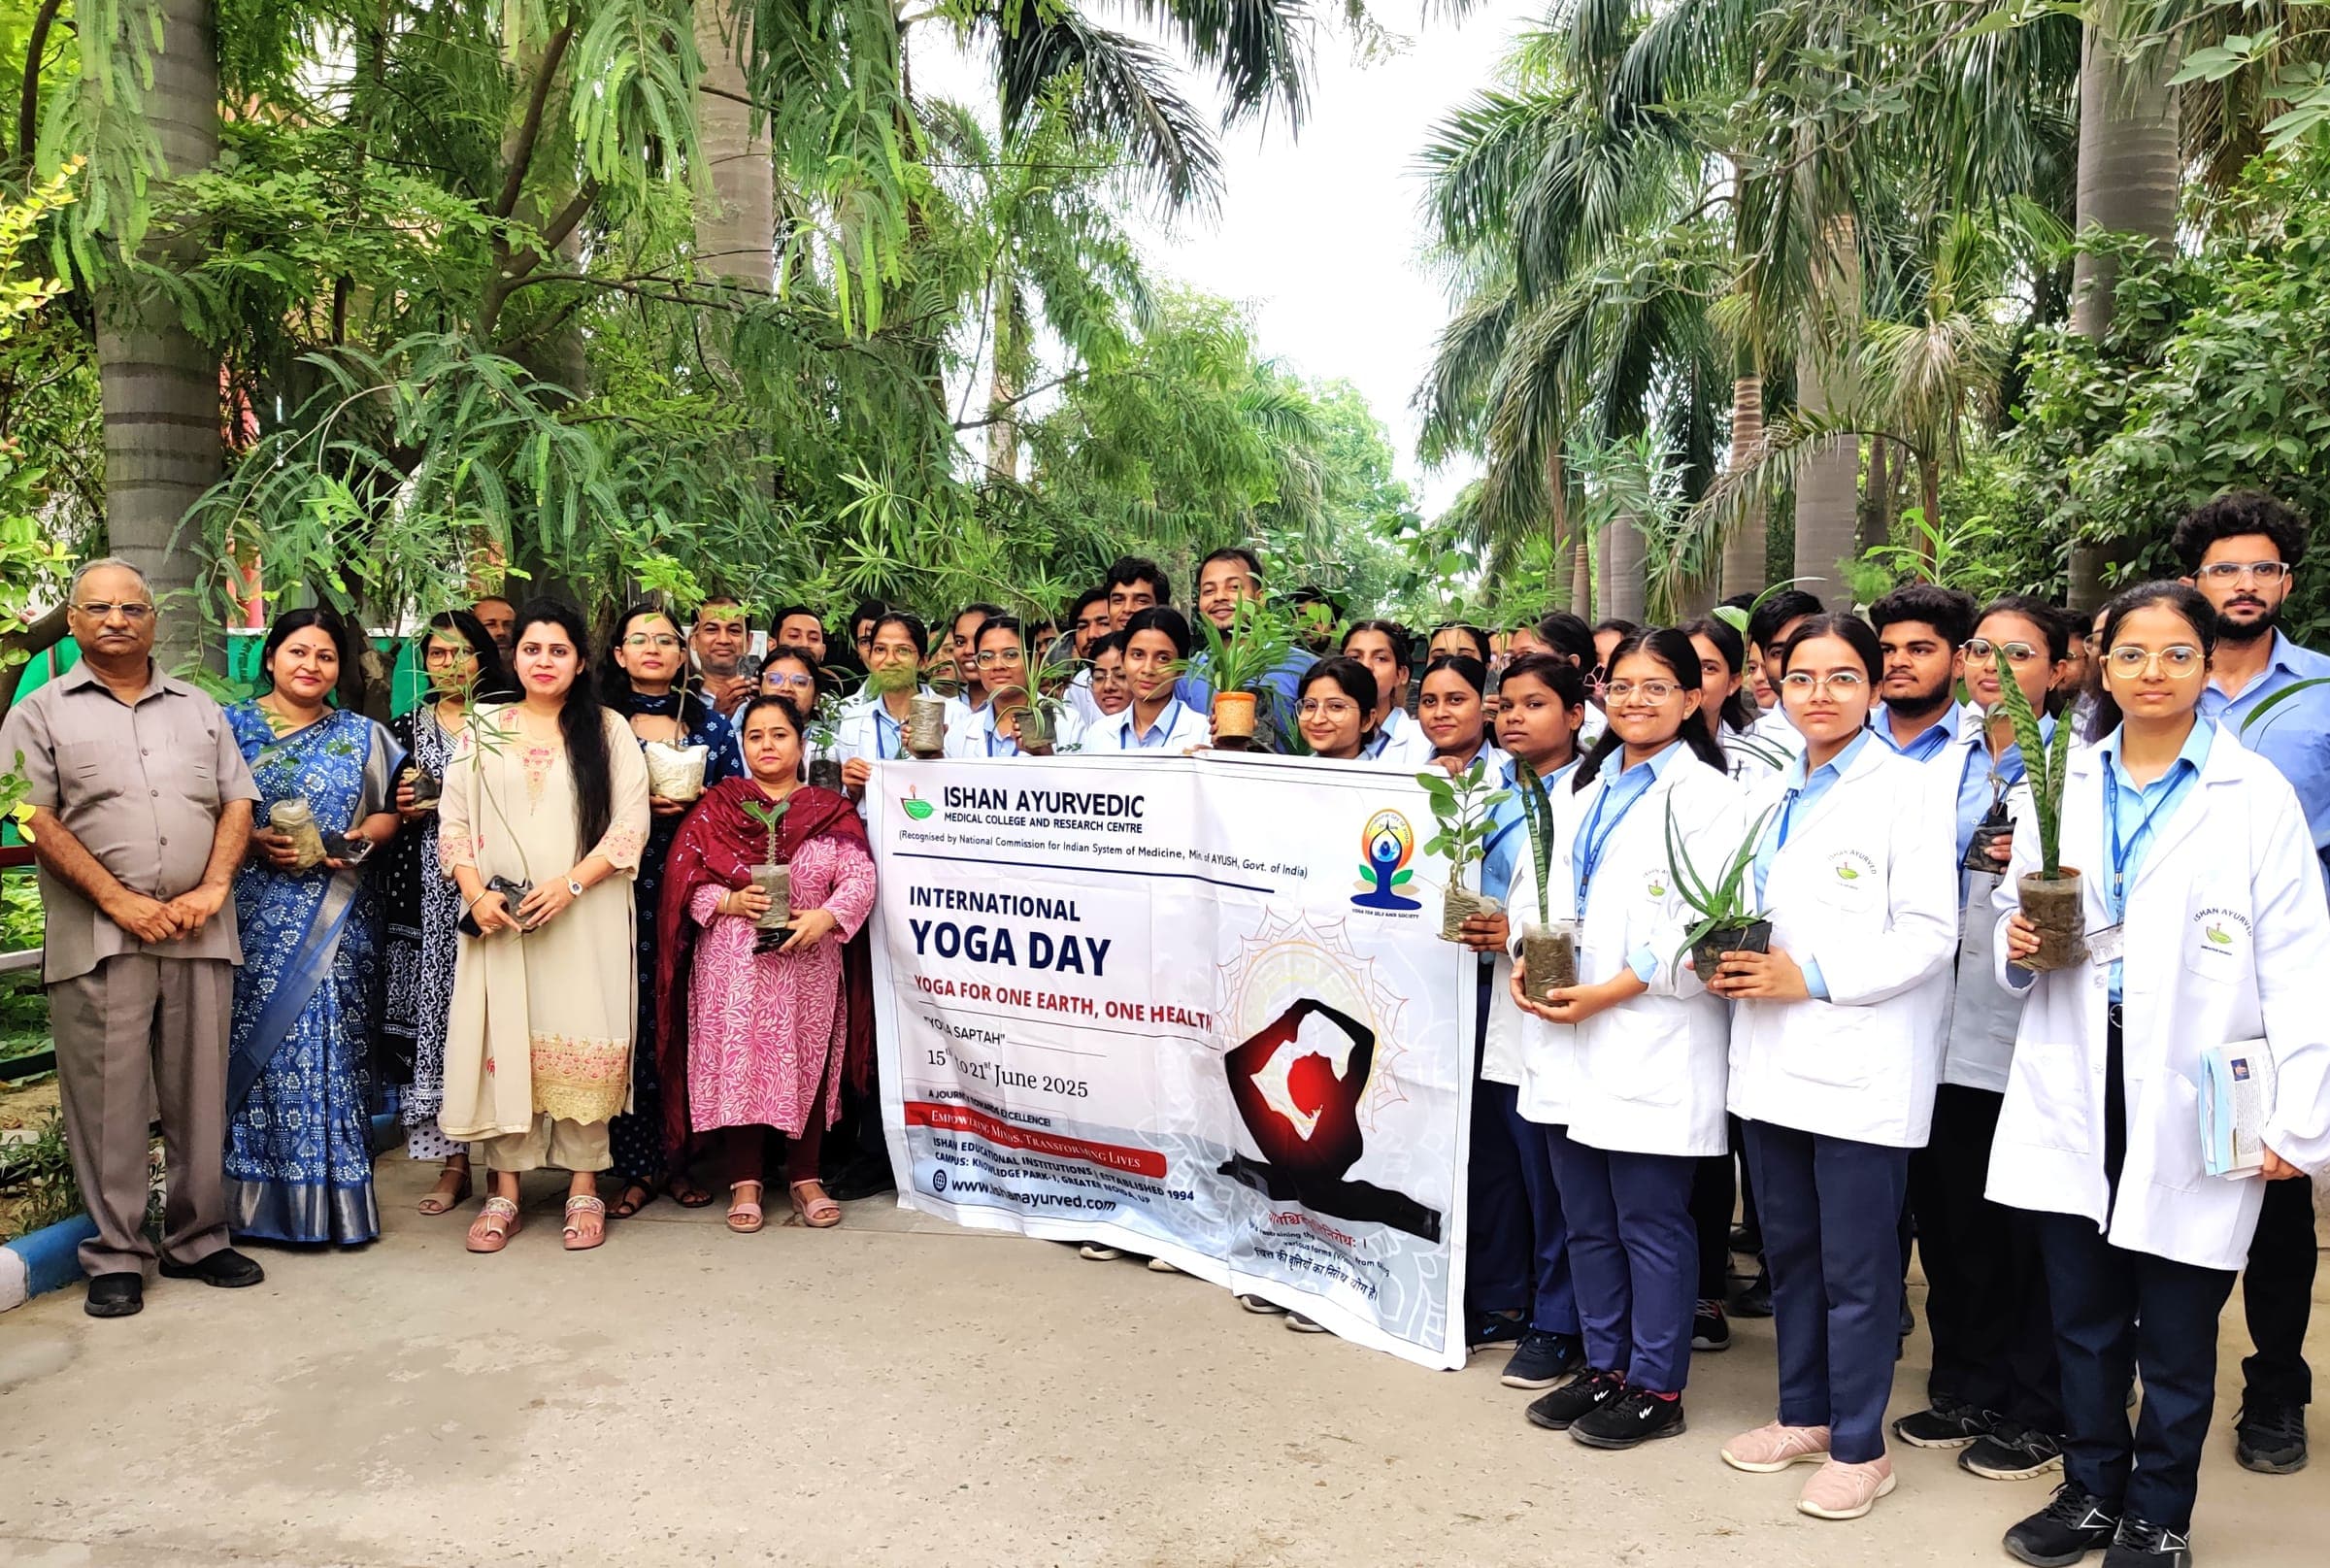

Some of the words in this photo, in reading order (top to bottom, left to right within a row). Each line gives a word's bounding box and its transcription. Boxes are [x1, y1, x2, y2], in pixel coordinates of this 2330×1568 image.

[944, 786, 1007, 811] ISHAN
[1015, 789, 1145, 818] AYURVEDIC
[945, 813, 982, 824] MEDICAL
[985, 815, 1026, 826] COLLEGE
[1029, 817, 1049, 828] AND
[1053, 818, 1103, 831] RESEARCH
[1107, 822, 1143, 834] CENTRE
[899, 830, 945, 843] (Recognised
[948, 834, 957, 845] by
[959, 834, 993, 847] National
[995, 837, 1046, 850] Commission
[1048, 840, 1060, 851] for
[1063, 842, 1089, 852] Indian
[1092, 844, 1122, 856] System
[1126, 846, 1136, 856] of
[1138, 847, 1185, 860] Medicine,
[1212, 853, 1240, 870] AYUSH,
[1243, 859, 1267, 872] Govt.
[1270, 863, 1281, 873] of
[1282, 864, 1308, 879] India)
[910, 885, 1081, 921] INTERNATIONAL
[2193, 907, 2219, 922] ISHAN
[909, 918, 1016, 966] YOGA
[1029, 931, 1112, 976] DAY
[915, 975, 956, 997] YOGA
[960, 983, 991, 1002] FOR
[996, 986, 1031, 1007] ONE
[1037, 991, 1099, 1018] EARTH,
[1105, 1000, 1145, 1021] ONE
[1150, 1005, 1213, 1034] HEALTH
[923, 1016, 952, 1037] "YOA
[953, 1025, 1006, 1046] SAPTAH"
[995, 1064, 1038, 1089] June
[1043, 1076, 1088, 1098] 2025
[933, 1137, 958, 1151] ISHAN
[961, 1141, 1019, 1166] EDUCATIONAL
[1022, 1156, 1093, 1176] INSTITUTIONS
[1100, 1172, 1165, 1196] ESTABLISHED
[1167, 1189, 1194, 1201] 1994
[935, 1151, 969, 1166] CAMPUS:
[972, 1157, 1020, 1179] KNOWLEDGE
[1061, 1176, 1103, 1189] GREATER
[951, 1180, 1116, 1212] www.ishanayurved.com
[1276, 1250, 1288, 1263] की
[1313, 1262, 1325, 1275] का
[1350, 1277, 1368, 1294] योग
